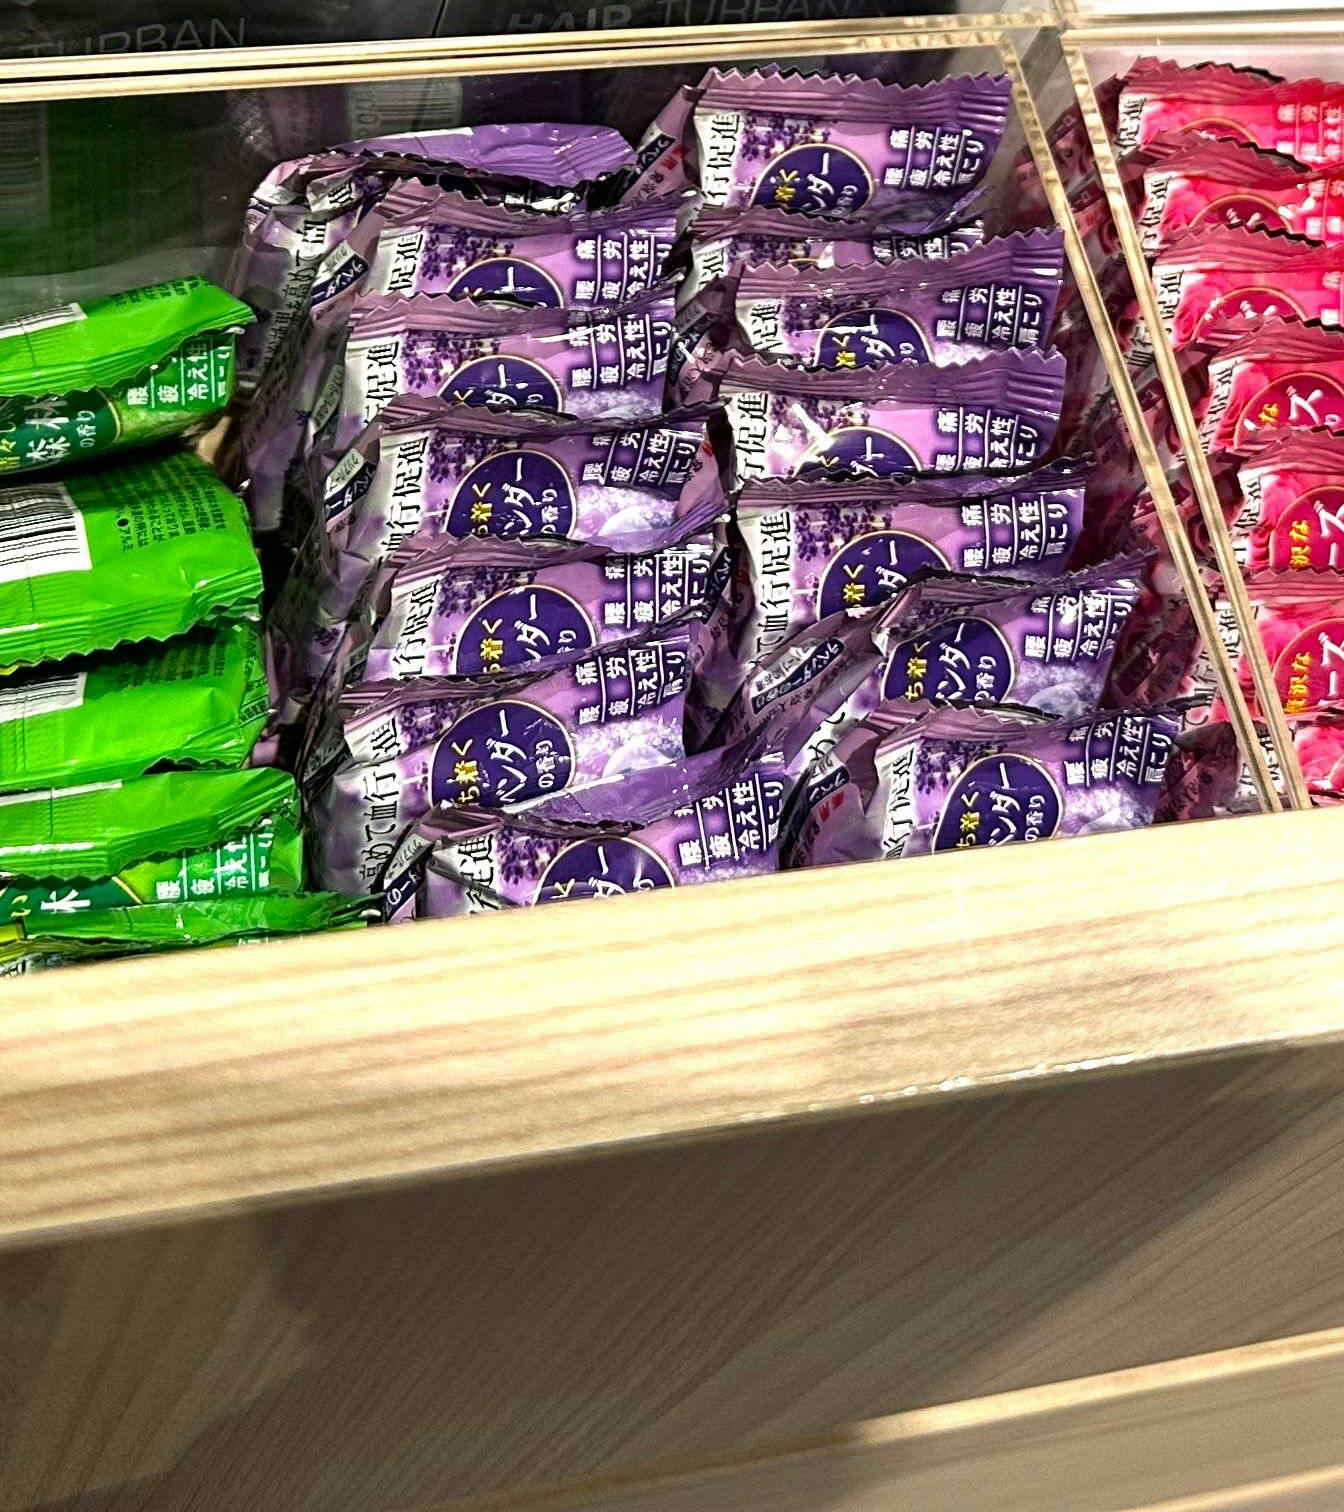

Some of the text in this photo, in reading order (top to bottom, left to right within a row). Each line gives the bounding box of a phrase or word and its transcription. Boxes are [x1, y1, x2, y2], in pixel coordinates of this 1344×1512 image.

[882, 129, 909, 185] 腰痛
[910, 130, 934, 187] 疲労
[934, 132, 961, 186] 冷え性
[386, 232, 424, 291] 促進
[575, 239, 598, 300] 腰痛
[602, 239, 623, 299] 疲労
[626, 240, 650, 298] 冷え性
[936, 289, 963, 337] 腰痛
[964, 286, 989, 337] 疲労
[992, 286, 1017, 340] 冷え性
[1018, 292, 1043, 343] 肩こり
[598, 324, 621, 384] 疲労
[624, 318, 647, 380] 冷え性
[76, 410, 97, 448] の香り
[639, 433, 668, 484] 冷え性
[962, 504, 985, 567] 腰痛
[988, 504, 1013, 564] 疲労
[1016, 501, 1041, 560] 冷え性
[1045, 503, 1070, 555] 肩こり
[605, 555, 626, 624] 腰痛
[633, 555, 656, 623] 疲労
[660, 555, 684, 616] 冷え性
[1026, 596, 1049, 656] 腰痛
[1052, 596, 1078, 657] 疲労
[1079, 595, 1106, 656] 冷え性
[577, 661, 601, 724] 腰痛
[605, 656, 631, 716] 疲労
[633, 650, 658, 706] 冷え性
[661, 650, 688, 696] 肩こり
[536, 740, 556, 788] の香り
[1116, 718, 1143, 777] 冷え性
[1144, 733, 1172, 783] 肩こり
[734, 781, 764, 850] 冷え性
[1024, 794, 1045, 841] の香り
